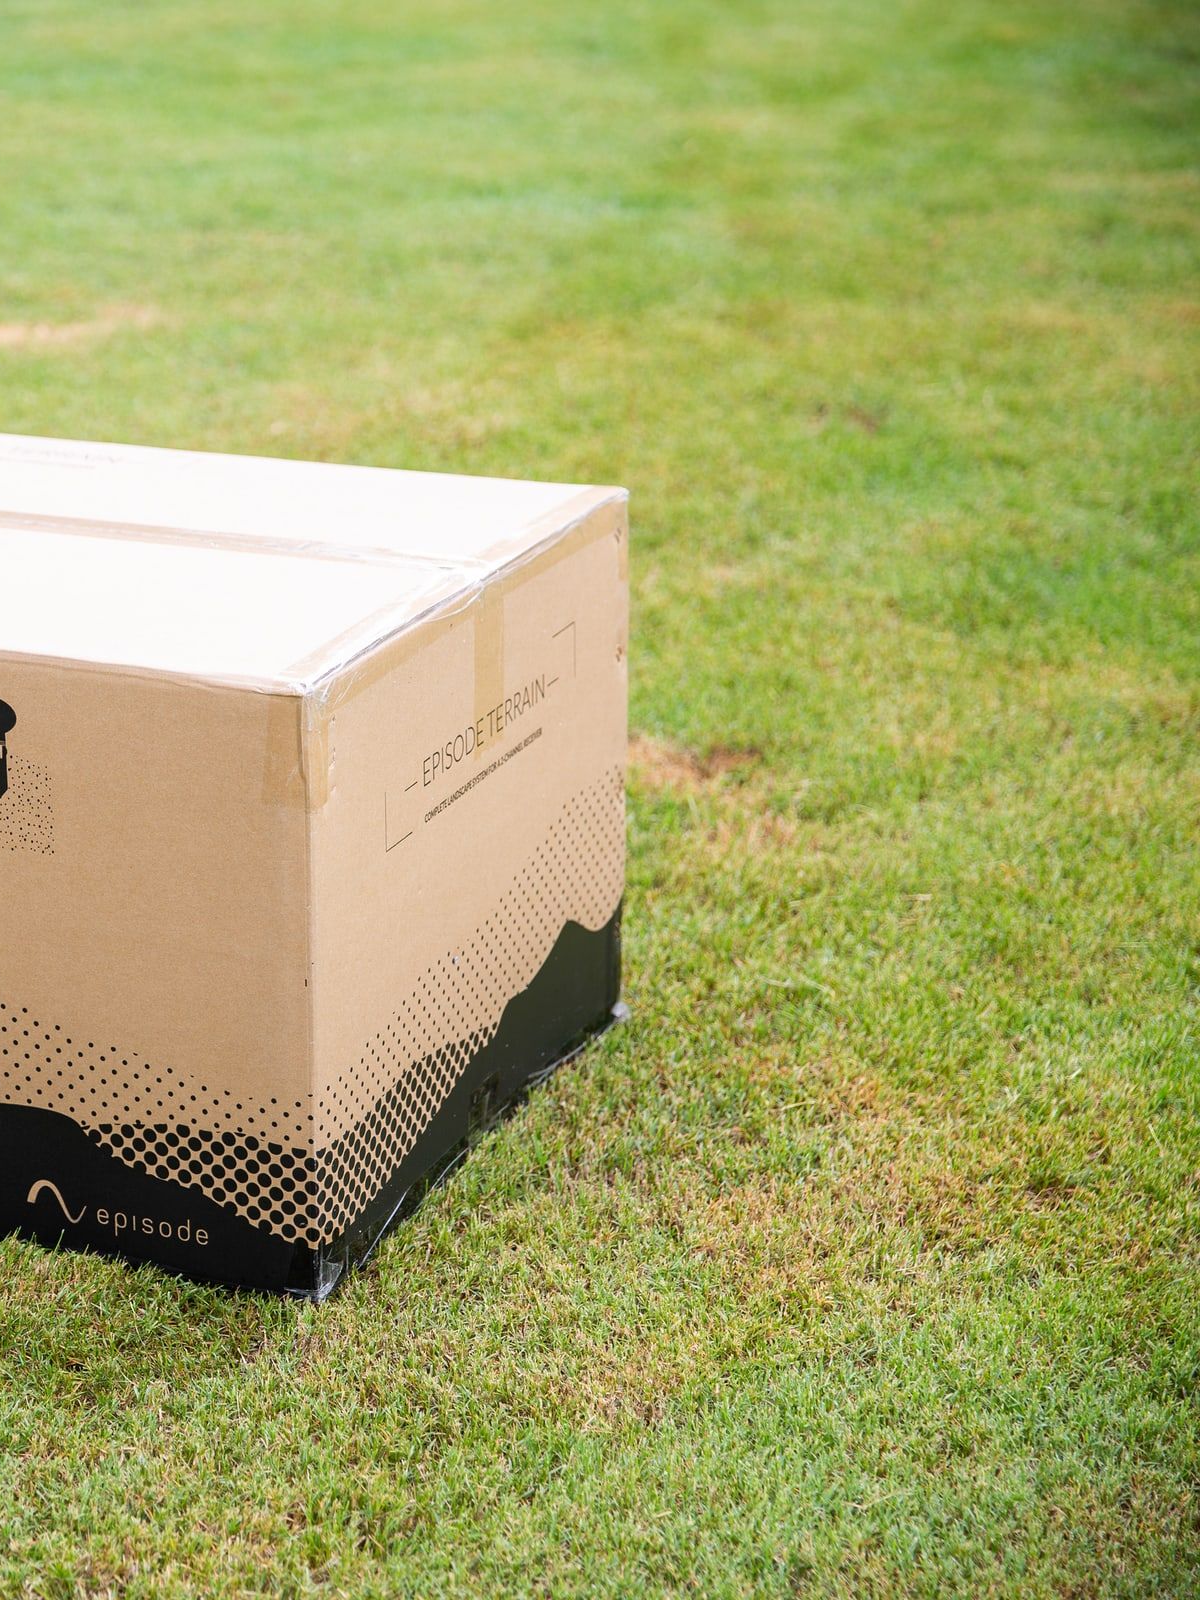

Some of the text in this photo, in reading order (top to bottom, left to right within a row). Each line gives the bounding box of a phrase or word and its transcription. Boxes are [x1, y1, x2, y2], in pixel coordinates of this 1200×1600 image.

[423, 673, 545, 787] EPISODE TERRAIN
[96, 1208, 209, 1245] episode
